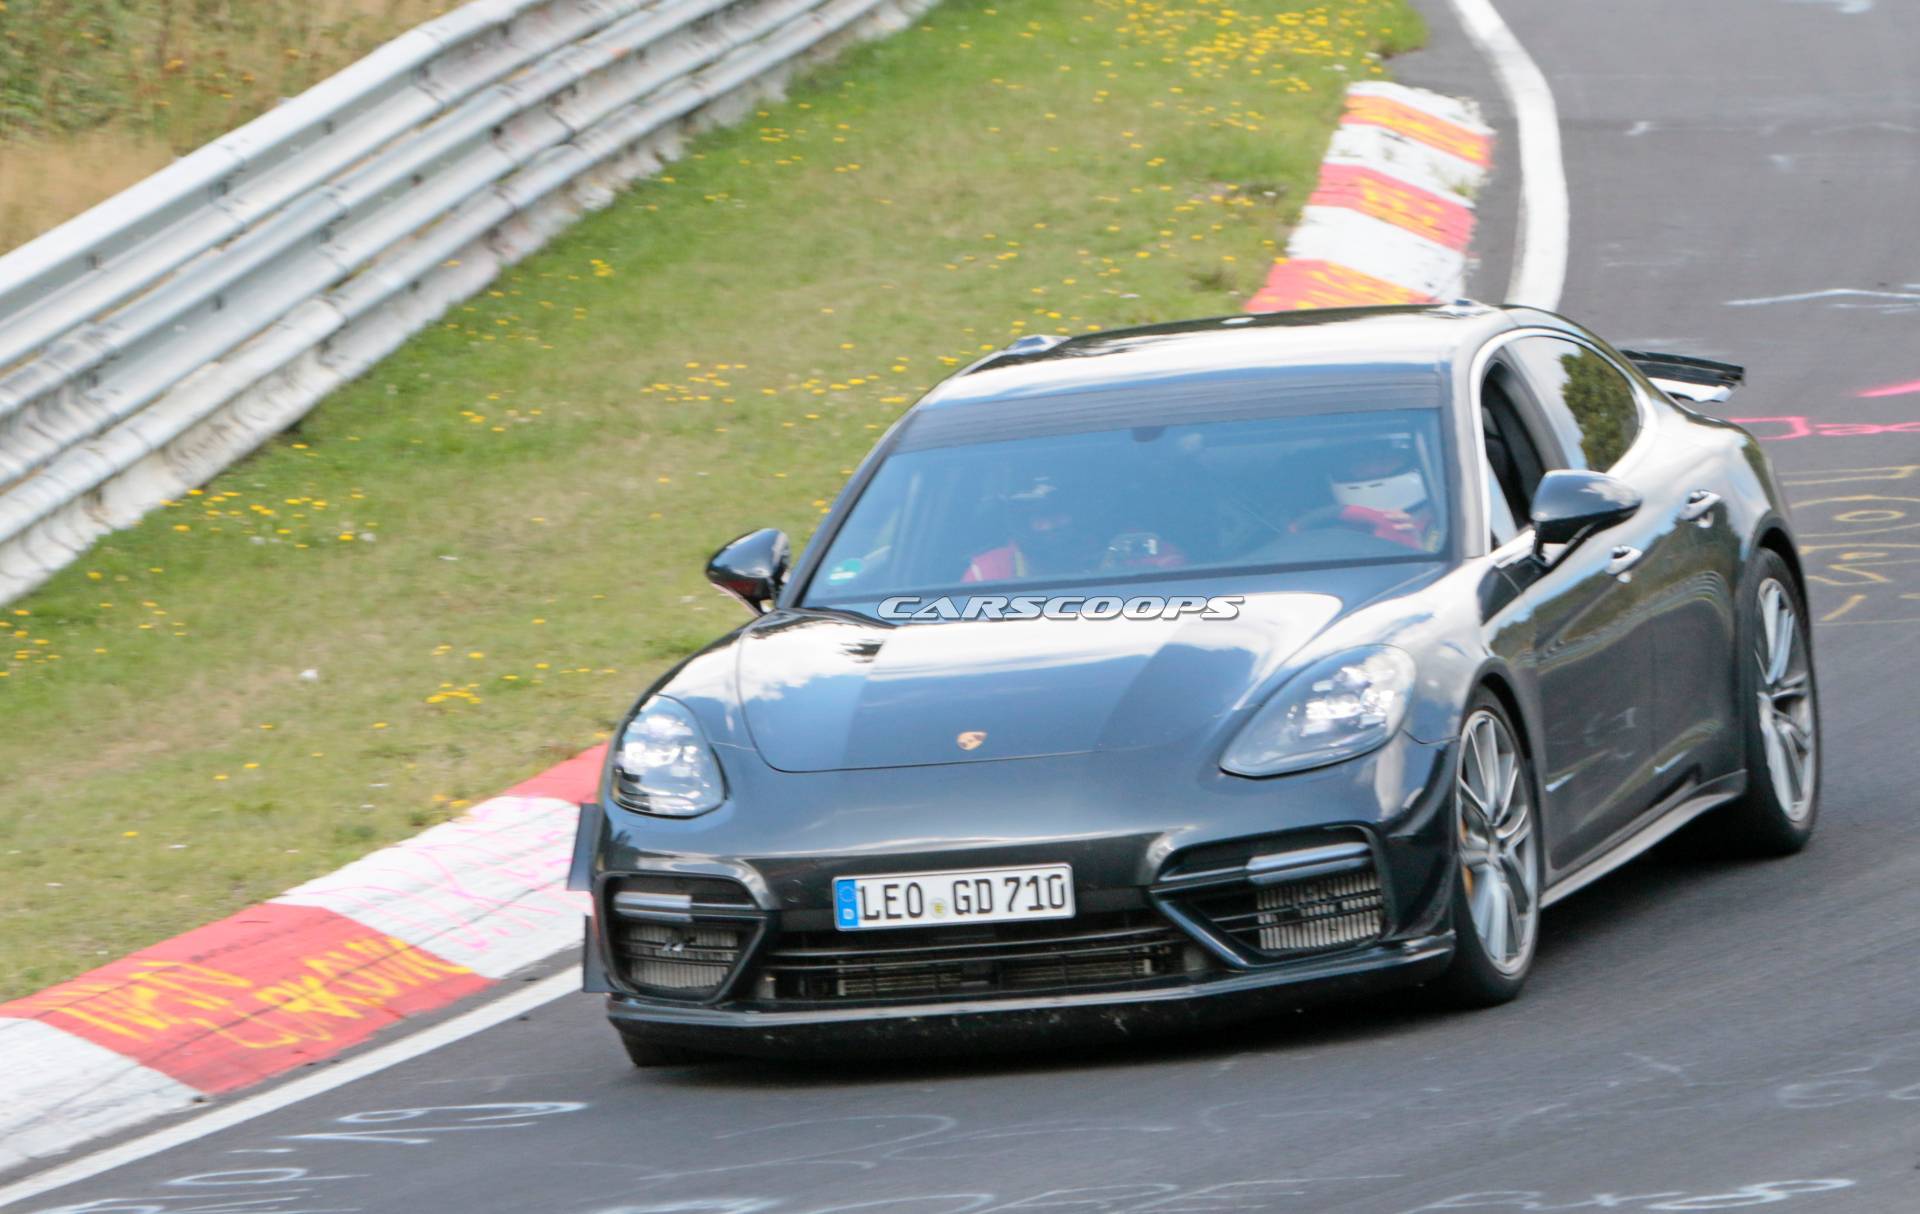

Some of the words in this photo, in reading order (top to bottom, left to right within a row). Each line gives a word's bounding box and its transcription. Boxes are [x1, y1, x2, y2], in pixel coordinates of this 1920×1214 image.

[859, 882, 924, 921] LEO
[952, 878, 994, 916] GD
[1003, 873, 1066, 913] 710
